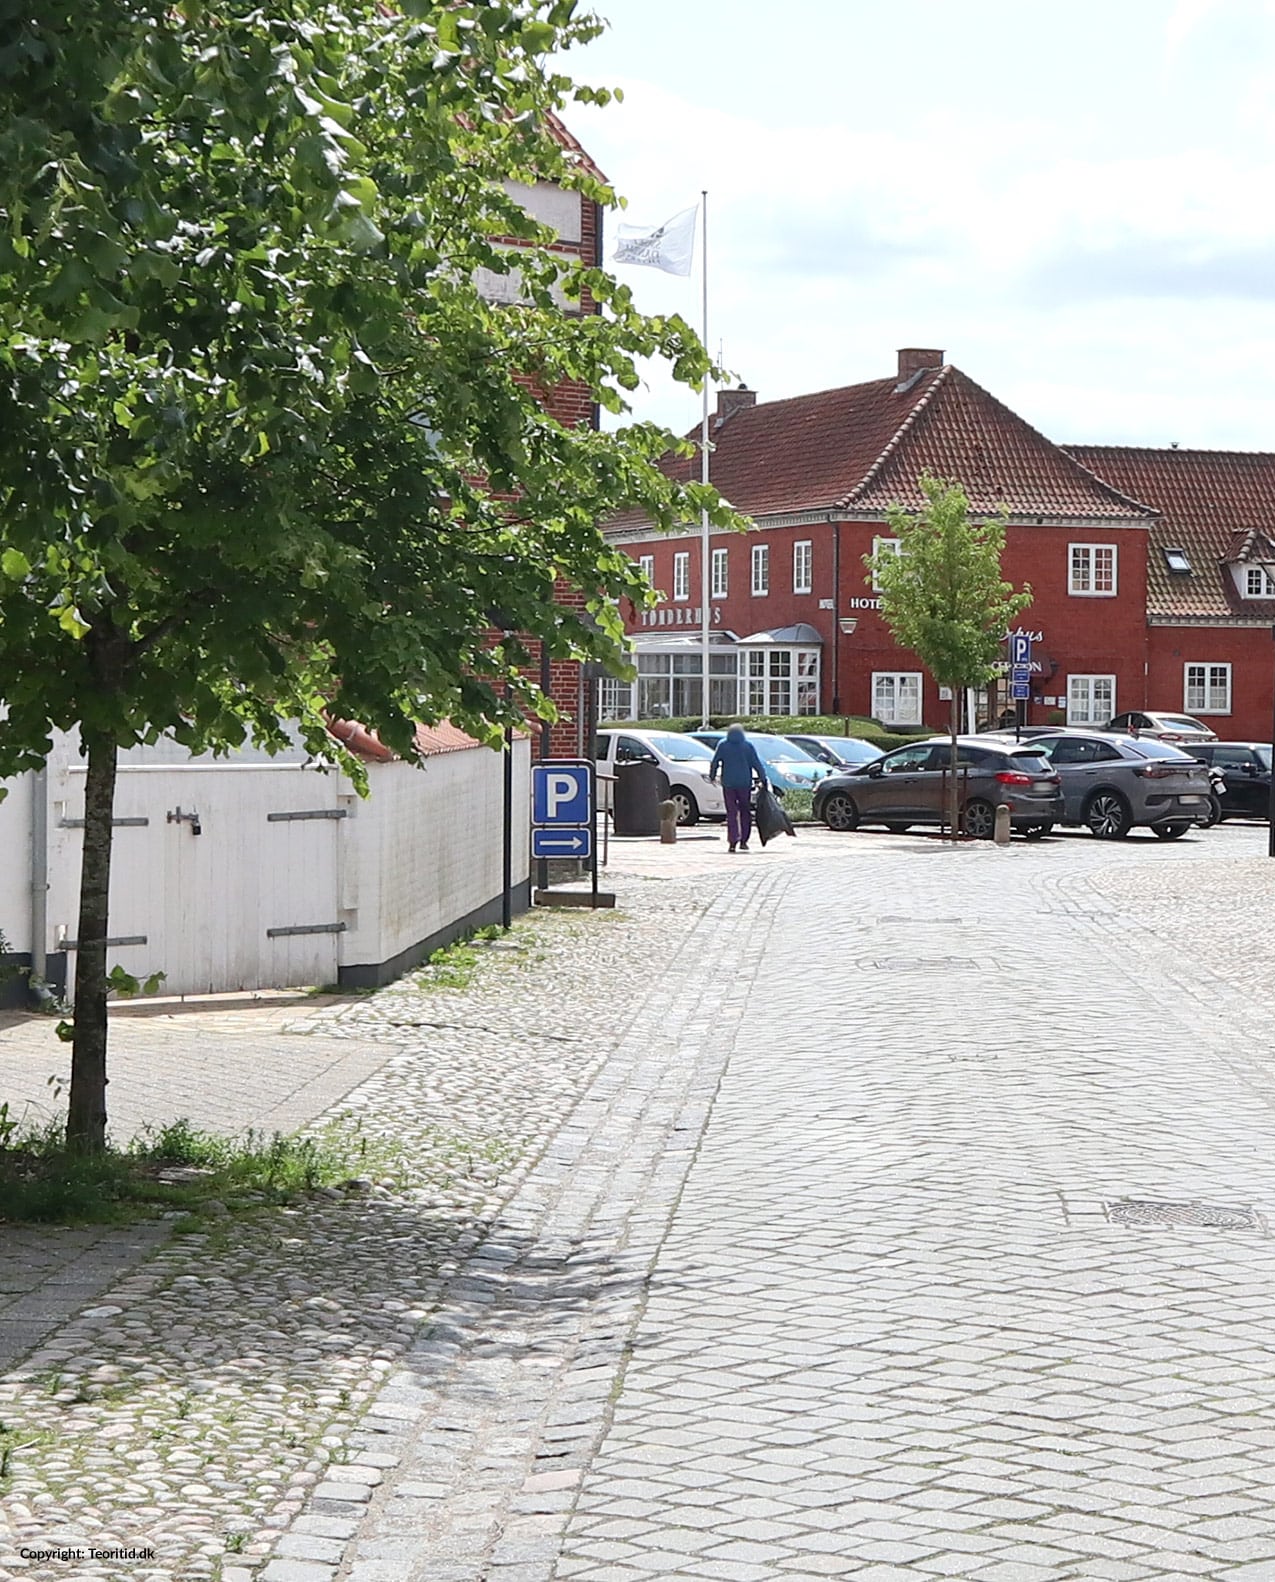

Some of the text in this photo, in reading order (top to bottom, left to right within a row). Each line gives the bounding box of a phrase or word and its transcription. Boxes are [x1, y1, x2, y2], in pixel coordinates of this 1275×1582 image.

[850, 598, 883, 609] HOTE
[1016, 638, 1027, 661] P
[547, 773, 578, 817] P
